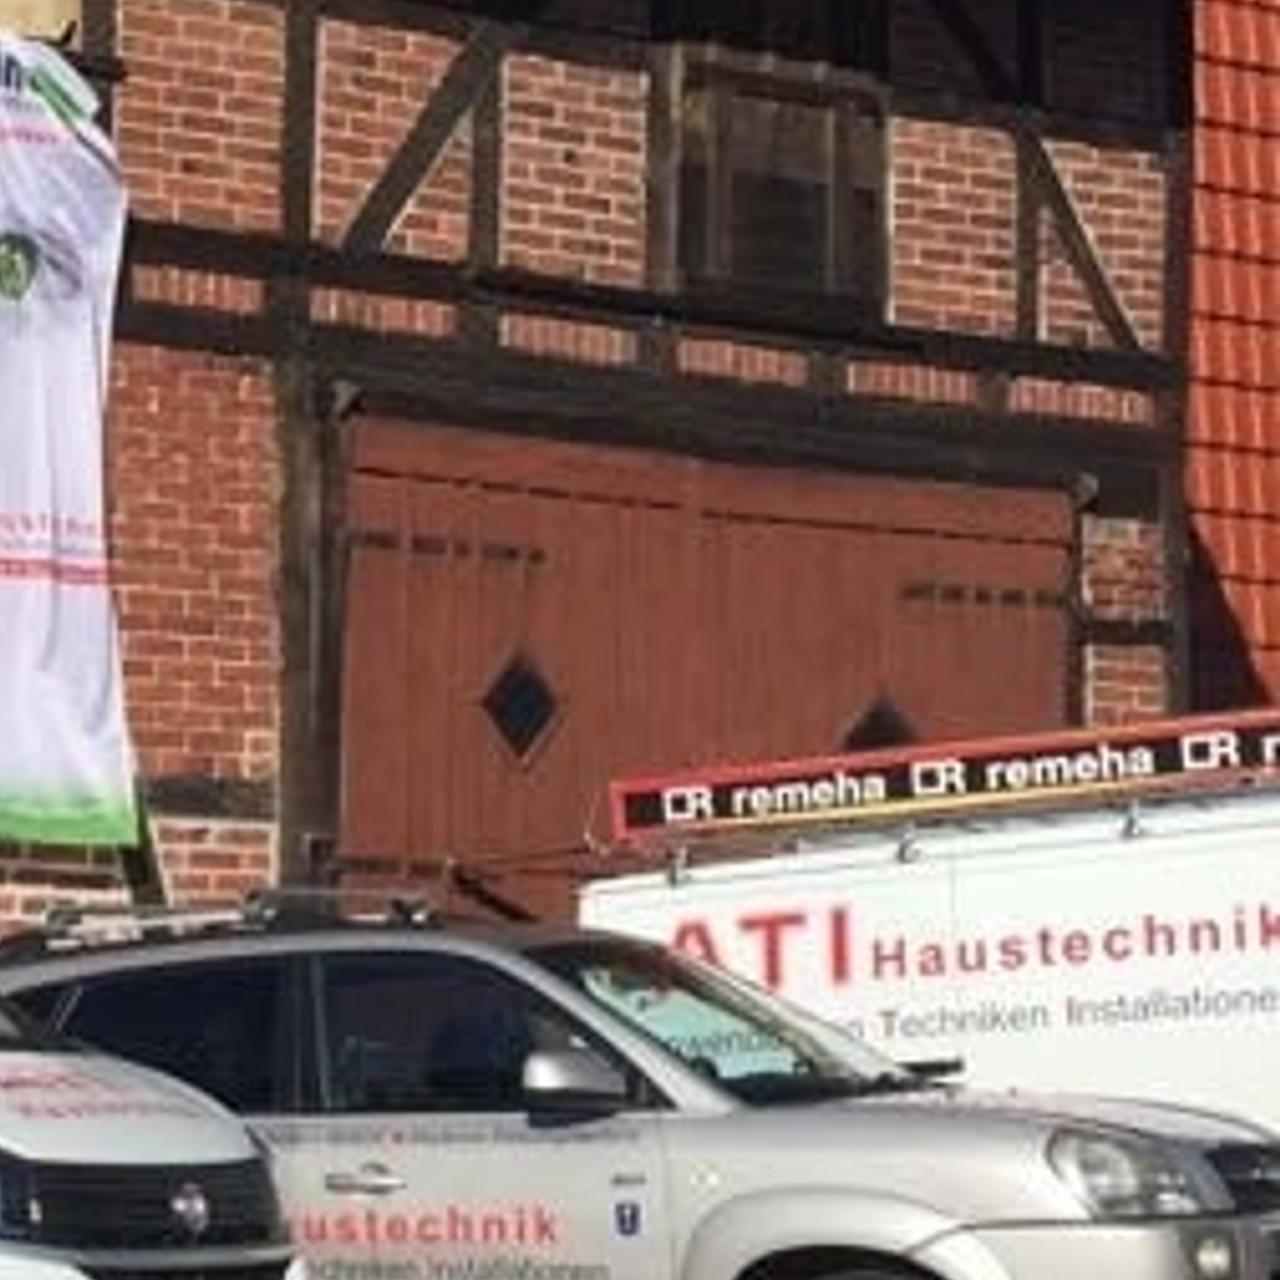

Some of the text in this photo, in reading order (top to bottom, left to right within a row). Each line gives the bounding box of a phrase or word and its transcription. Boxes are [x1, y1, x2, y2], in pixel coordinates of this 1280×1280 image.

[732, 771, 886, 816] remeha
[985, 743, 1155, 791] remeha
[871, 904, 1280, 979] Haustechnik
[877, 993, 1050, 1039] Techniken
[1066, 981, 1280, 1027] Installatione
[302, 1205, 559, 1245] ustechnik
